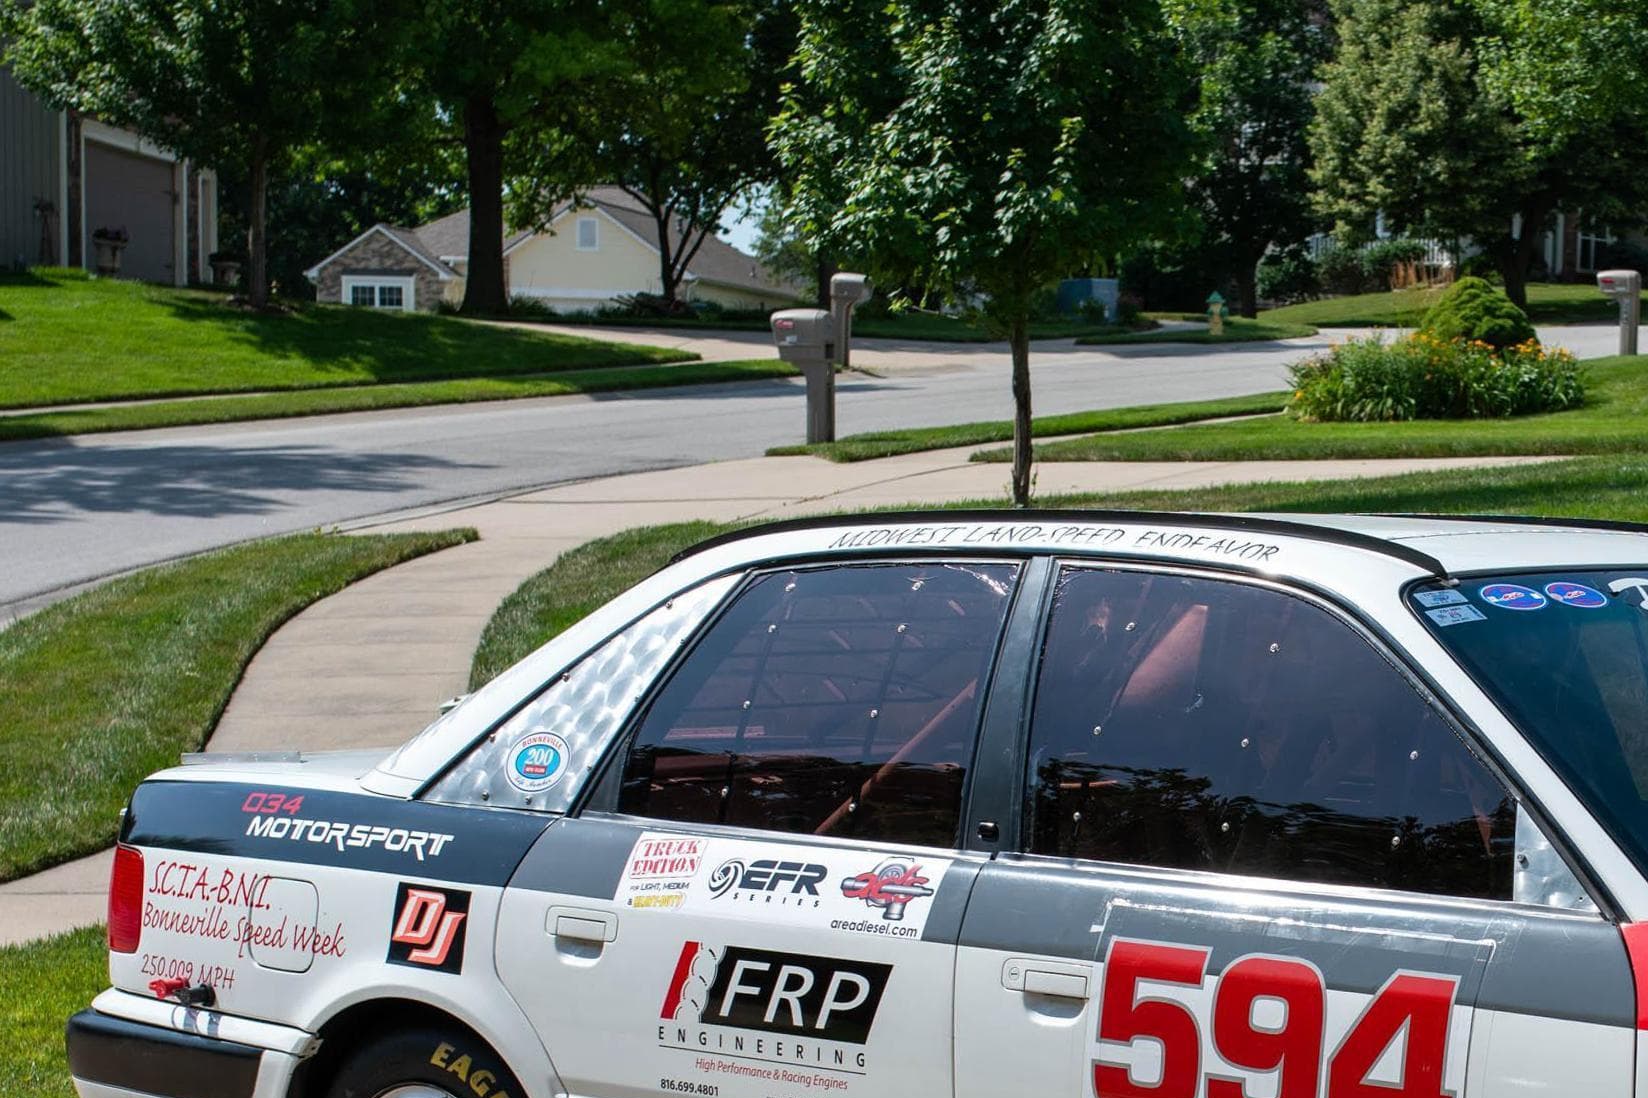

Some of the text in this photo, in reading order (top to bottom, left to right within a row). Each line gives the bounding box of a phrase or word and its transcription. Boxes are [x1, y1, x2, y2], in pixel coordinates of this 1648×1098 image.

[829, 524, 1281, 561] MIDWEST LAND-SPEED ENDEAVOR
[524, 748, 555, 766] 200
[241, 792, 304, 814] 034
[245, 815, 454, 861] MOTORSPORT
[644, 840, 700, 857] TRUCK
[631, 857, 700, 875] EDITION
[738, 860, 828, 896] EFR
[733, 892, 820, 908] SERIES
[143, 902, 346, 958] Bonneville Speed Week
[392, 889, 466, 966] DJ
[830, 919, 918, 938] areadiesel.com
[141, 953, 236, 990] 250.009 MPH
[718, 959, 871, 1030] FRP
[658, 1026, 866, 1068] ENGINEERING
[660, 1078, 719, 1097] 816.699.4801
[695, 1058, 848, 1090] High Performance & Racing Engines
